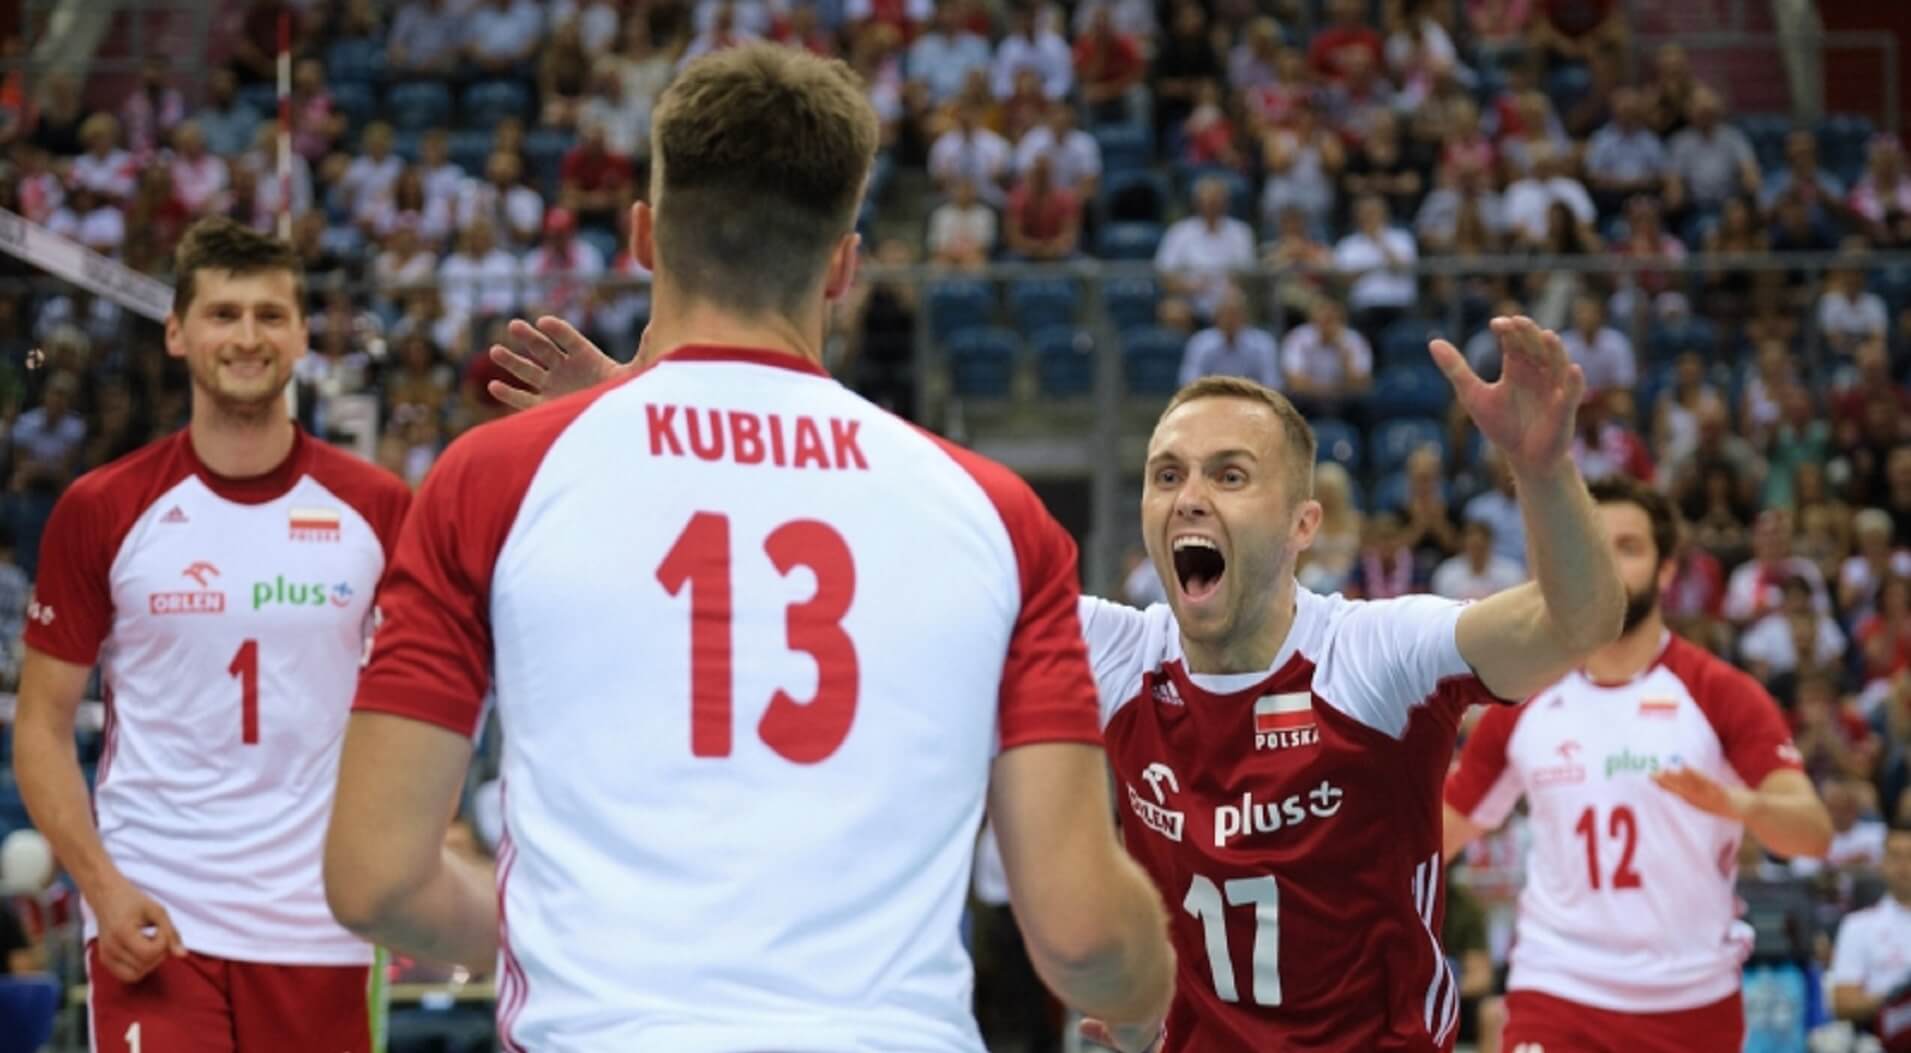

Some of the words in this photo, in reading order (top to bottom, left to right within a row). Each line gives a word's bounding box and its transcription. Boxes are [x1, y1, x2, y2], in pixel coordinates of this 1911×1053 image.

[645, 404, 869, 470] KUBIAK
[156, 594, 219, 611] ORLEN
[655, 510, 860, 765] 13
[228, 639, 259, 745] 1
[1256, 729, 1320, 750] POLSKA
[1576, 804, 1642, 890] 12
[1183, 873, 1282, 1007] 17
